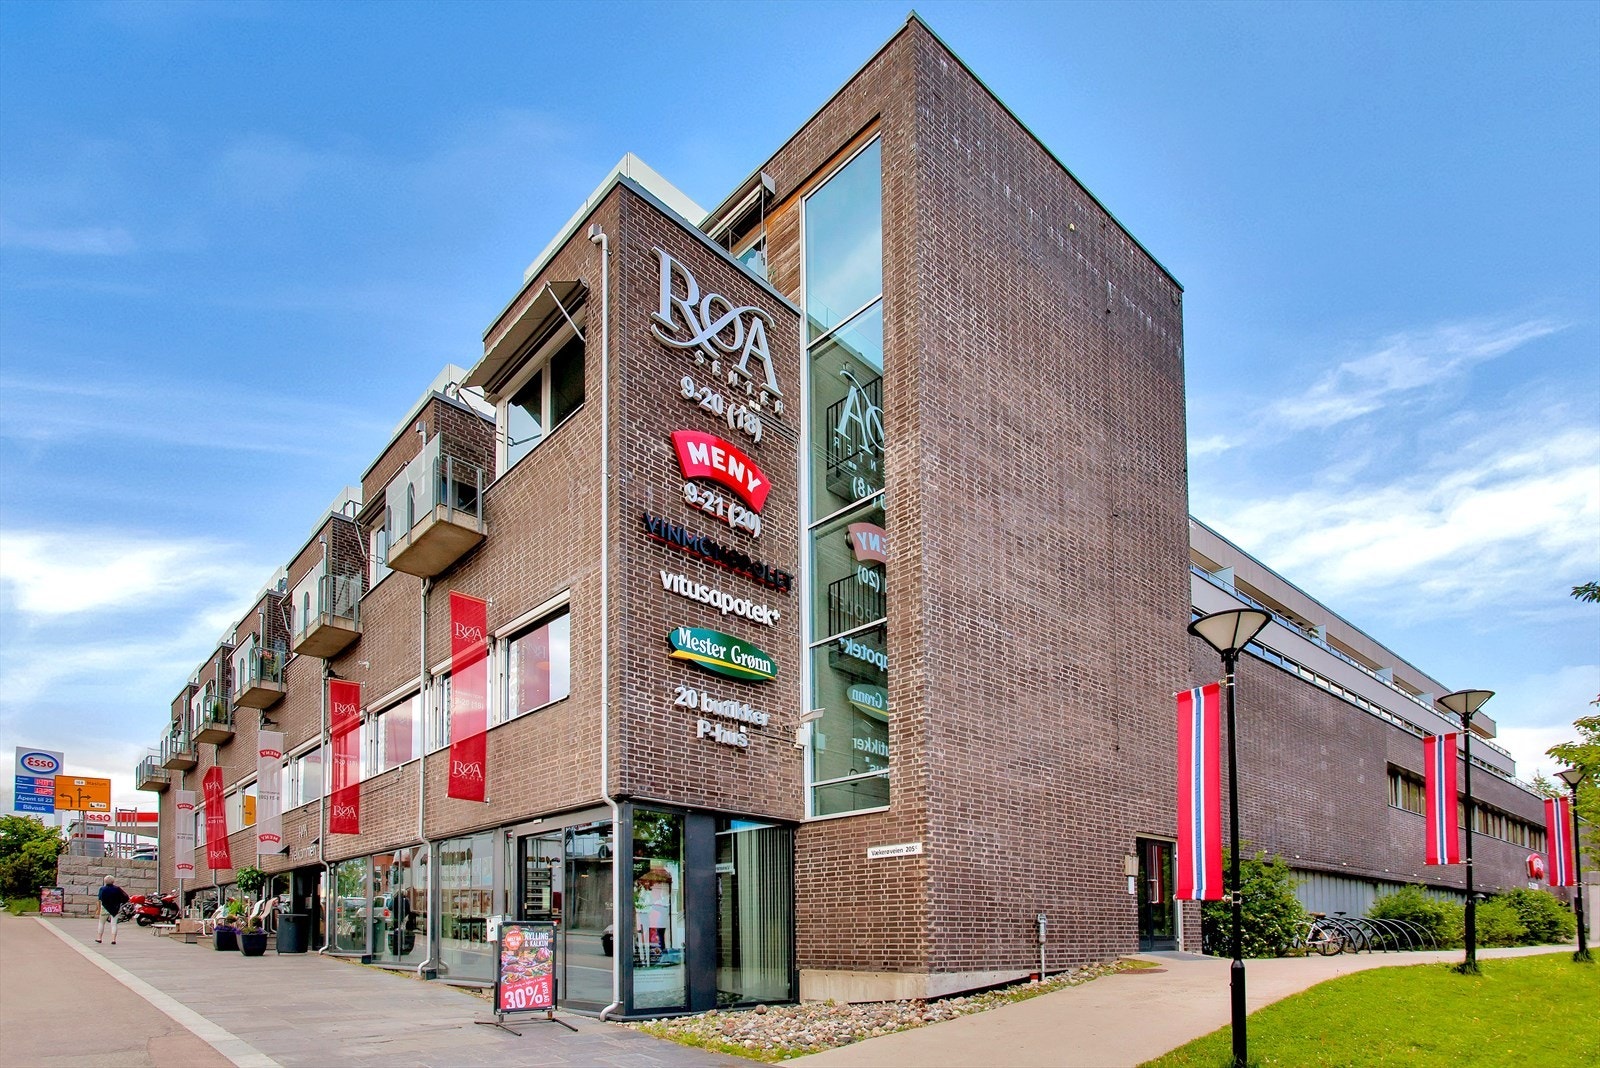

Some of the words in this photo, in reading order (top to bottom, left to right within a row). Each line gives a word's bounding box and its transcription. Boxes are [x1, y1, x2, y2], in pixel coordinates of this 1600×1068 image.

[695, 349, 784, 416] SENTER
[680, 376, 724, 417] 9-20
[727, 403, 762, 444] (18)
[686, 441, 762, 494] MENY
[683, 482, 724, 517] 9-21
[728, 503, 762, 538] (20)
[678, 627, 727, 660] Mester
[730, 645, 771, 674] Grønn
[674, 685, 697, 709] 20
[700, 691, 770, 726] butikker
[696, 719, 749, 748] P-hus
[524, 932, 549, 941] KYLLING
[504, 984, 544, 1009] 30%
